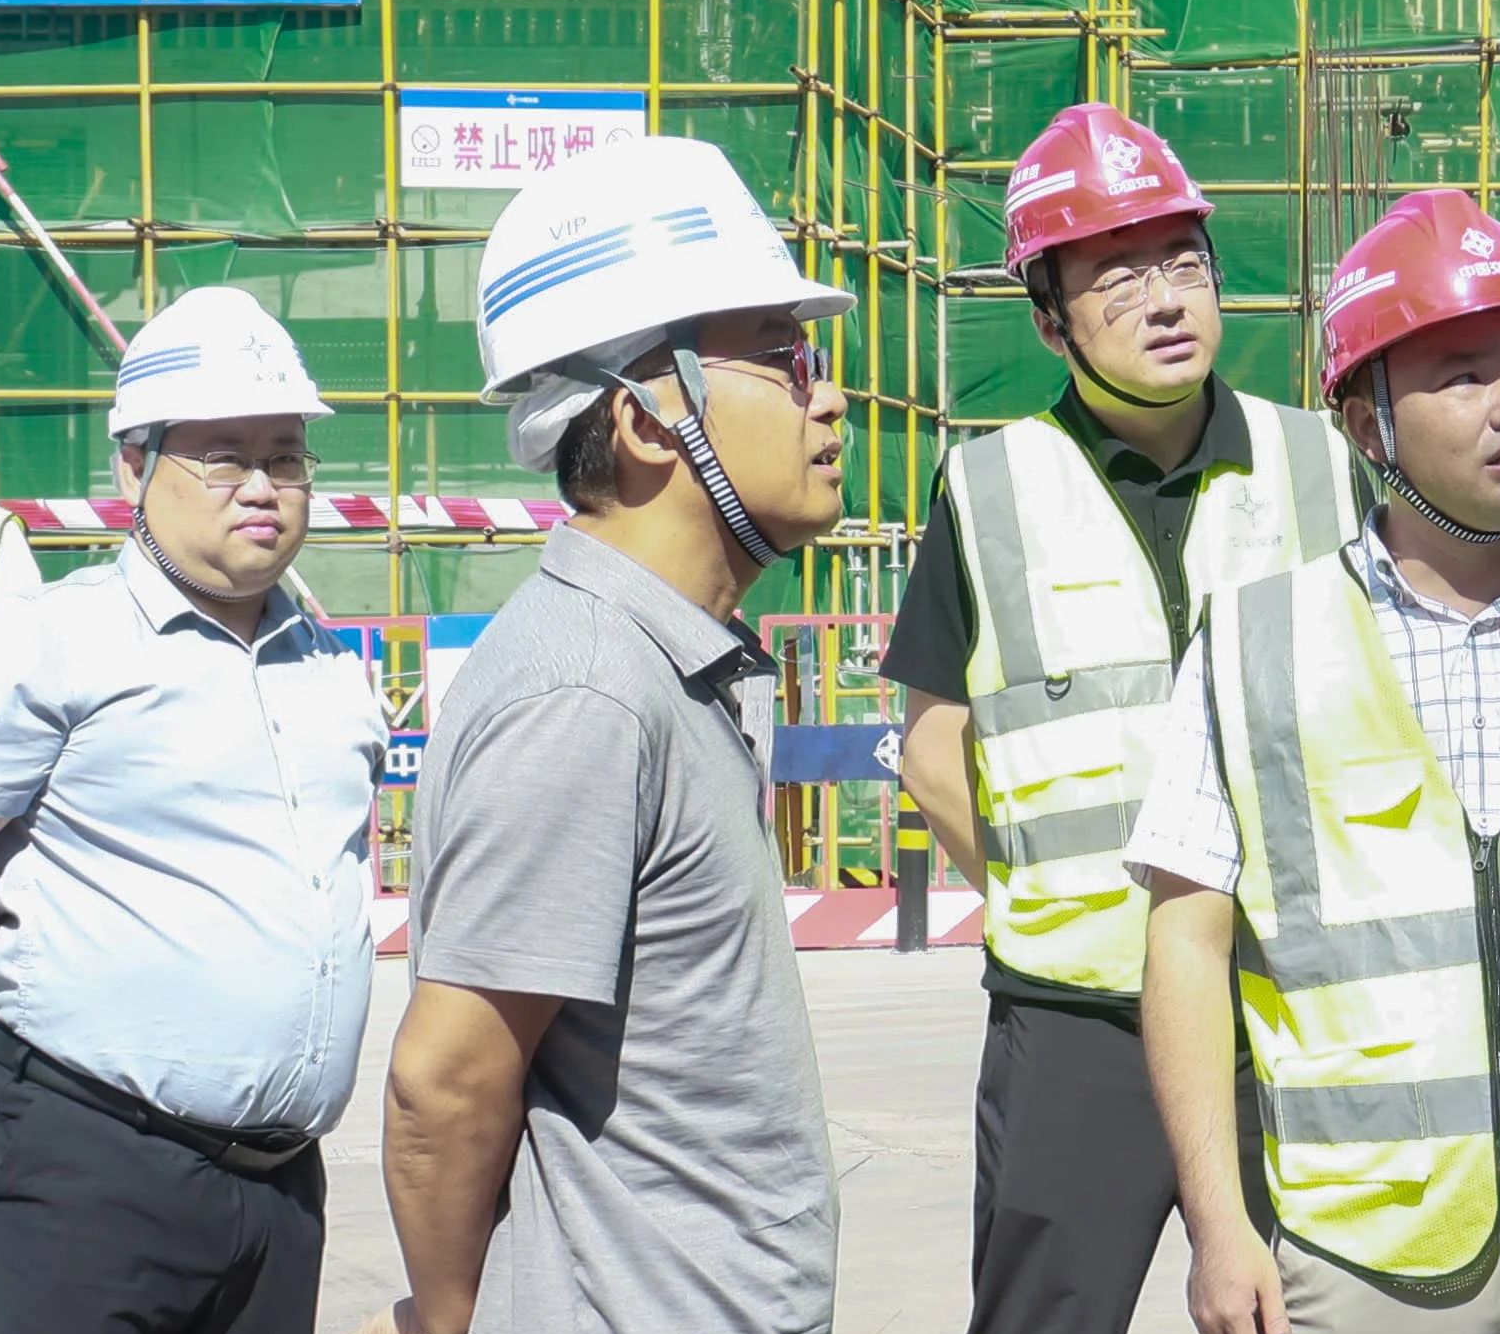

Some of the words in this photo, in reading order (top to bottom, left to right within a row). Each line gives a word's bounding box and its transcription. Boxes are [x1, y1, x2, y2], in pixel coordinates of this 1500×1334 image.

[453, 123, 594, 172] 禁止吸烟
[549, 216, 587, 241] VIP
